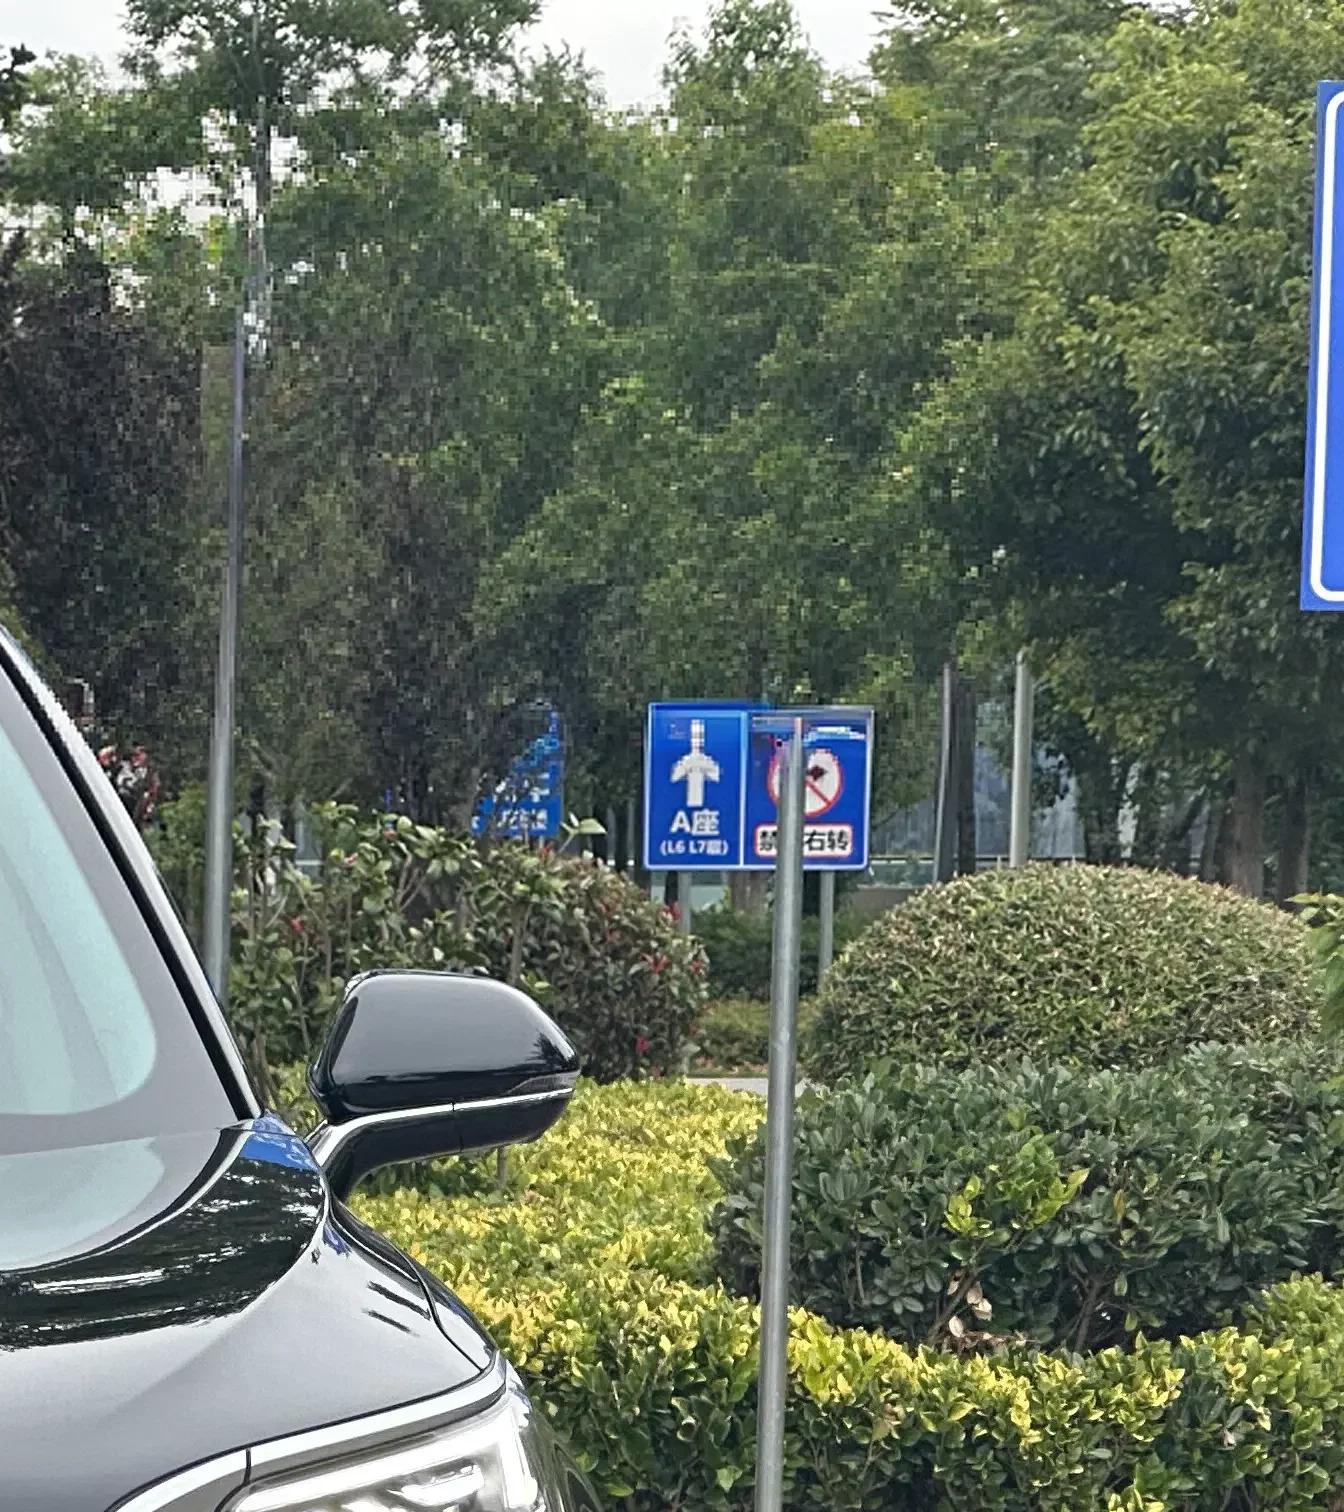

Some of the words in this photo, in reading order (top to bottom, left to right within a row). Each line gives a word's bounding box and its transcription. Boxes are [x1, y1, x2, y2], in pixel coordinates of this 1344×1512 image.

[669, 808, 720, 836] A座
[759, 829, 850, 852] 禁右转
